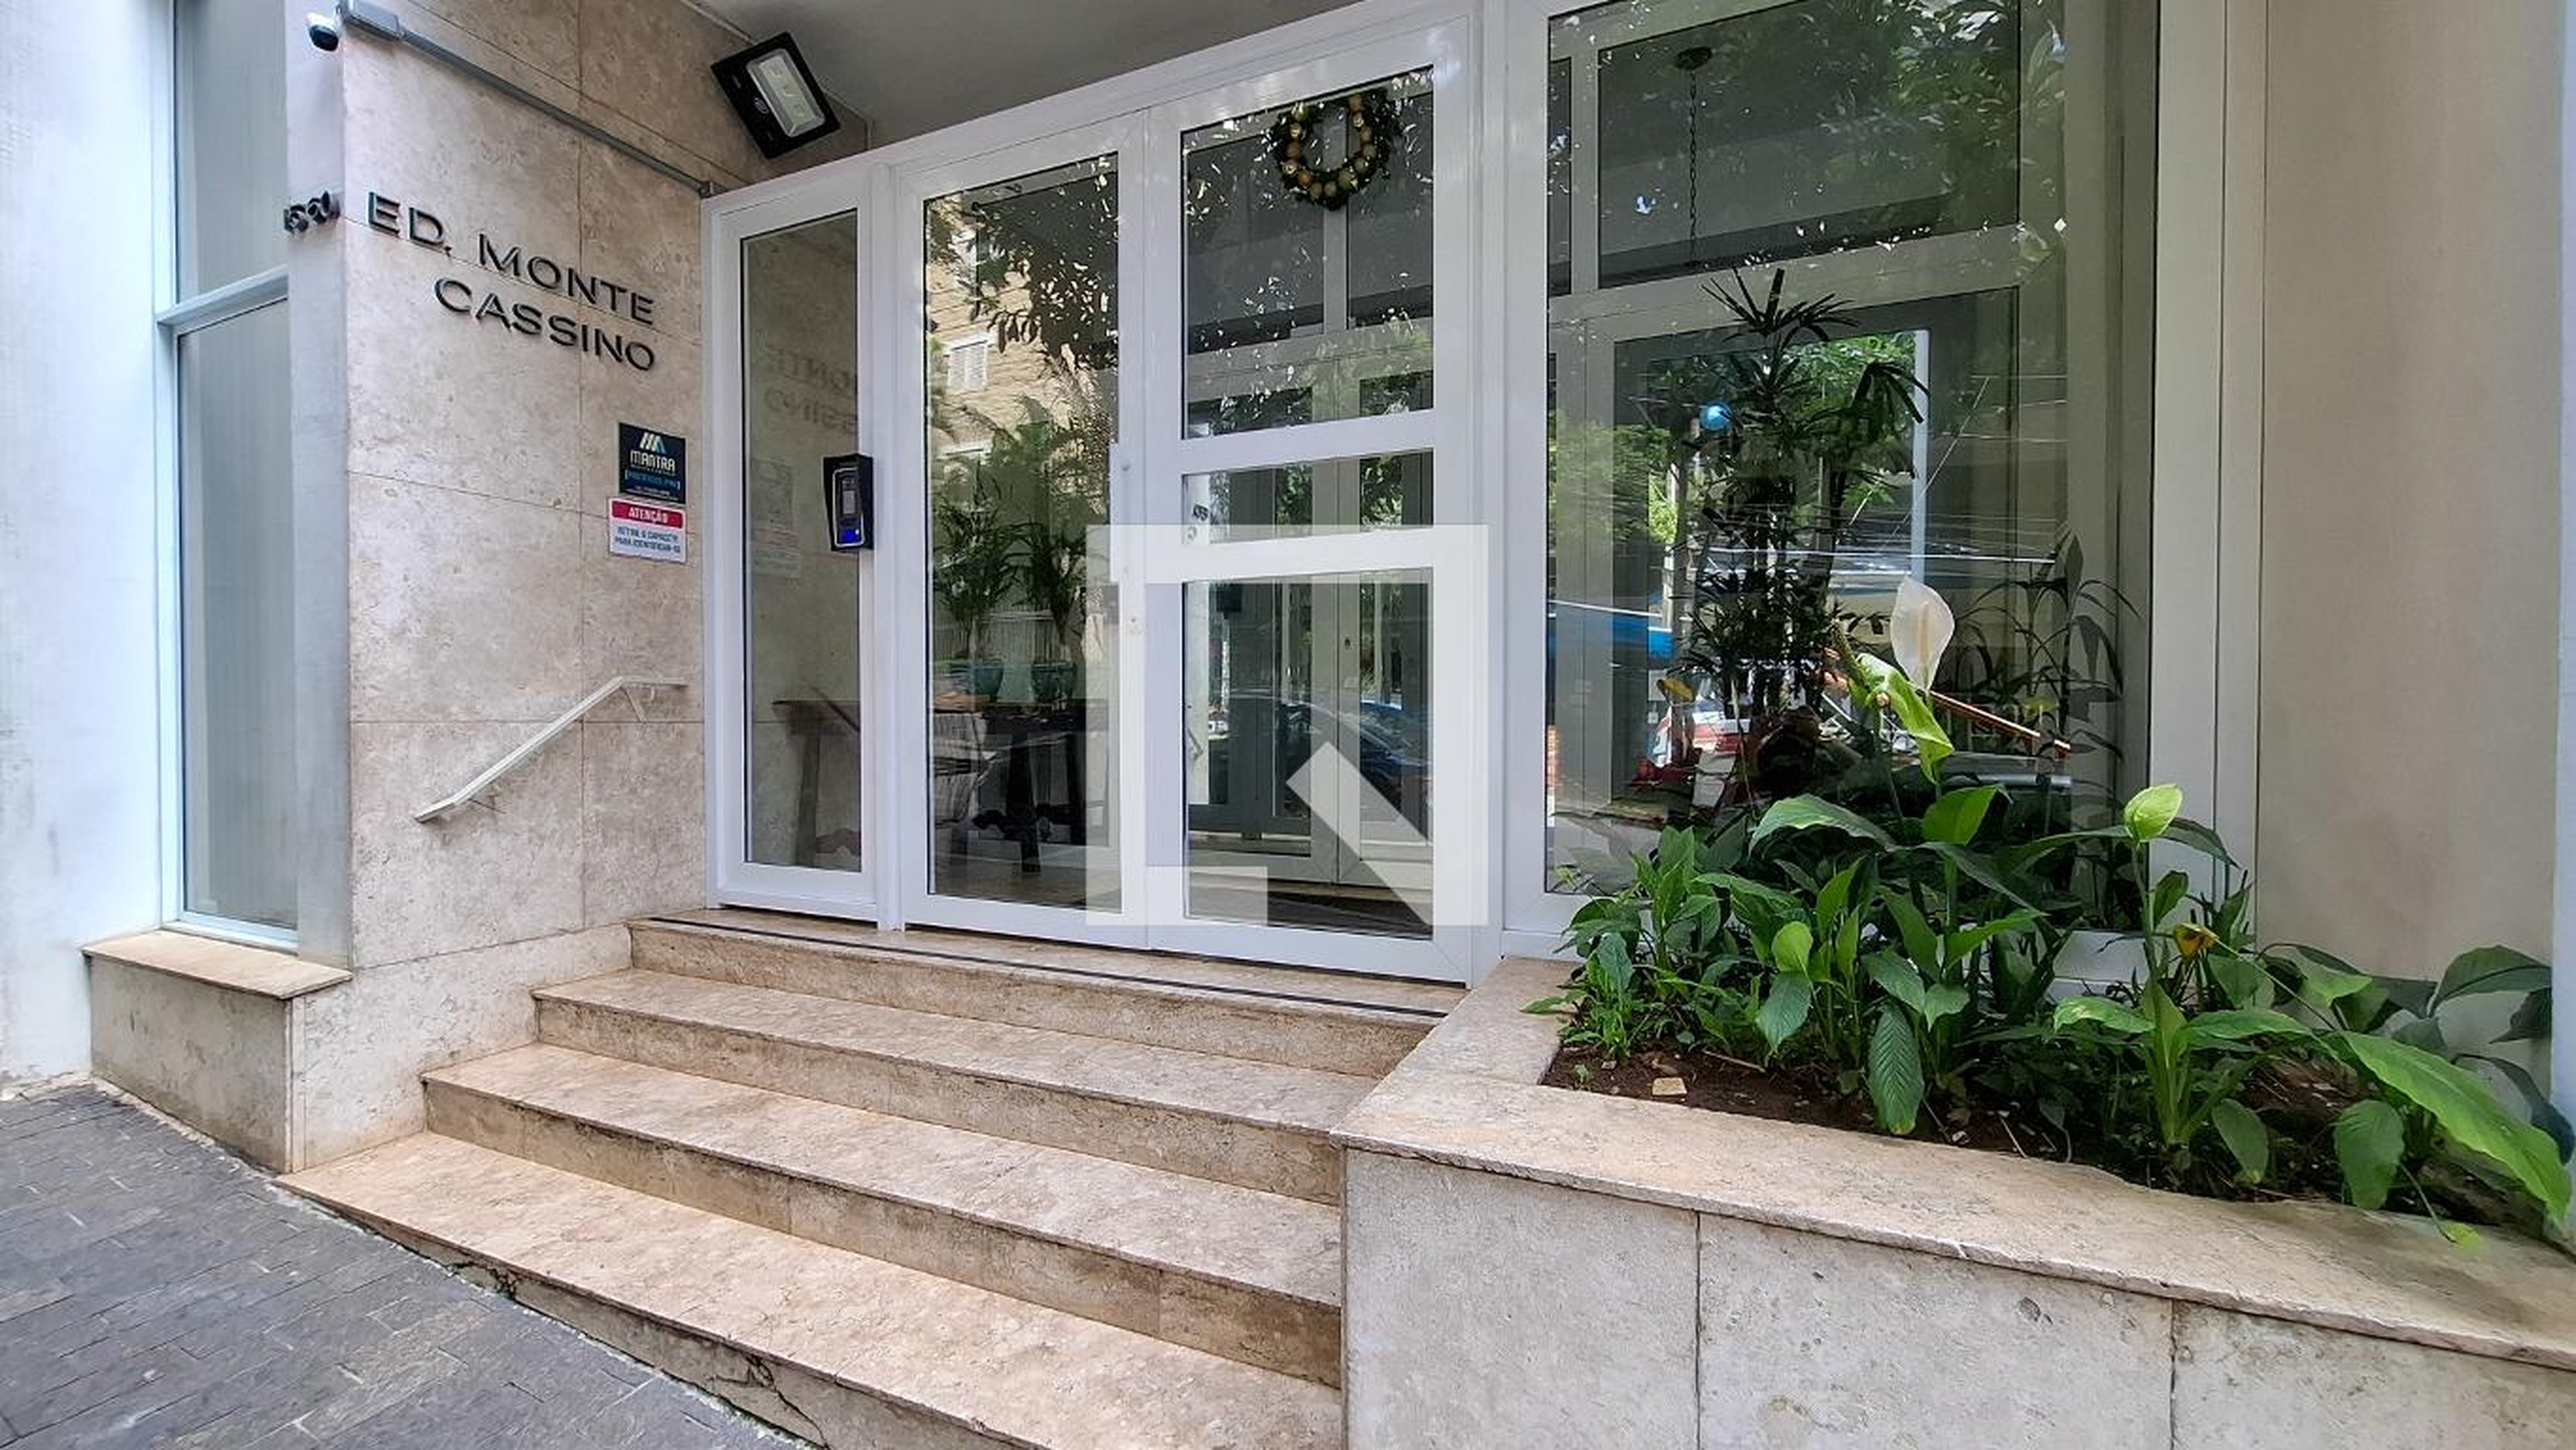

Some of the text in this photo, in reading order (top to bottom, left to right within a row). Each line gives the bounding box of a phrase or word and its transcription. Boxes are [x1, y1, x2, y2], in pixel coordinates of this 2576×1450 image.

[367, 191, 654, 325] ED. MONTE
[434, 277, 655, 371] CASSINO
[630, 450, 676, 471] MANTRA
[629, 506, 668, 523] ATENÇÃO
